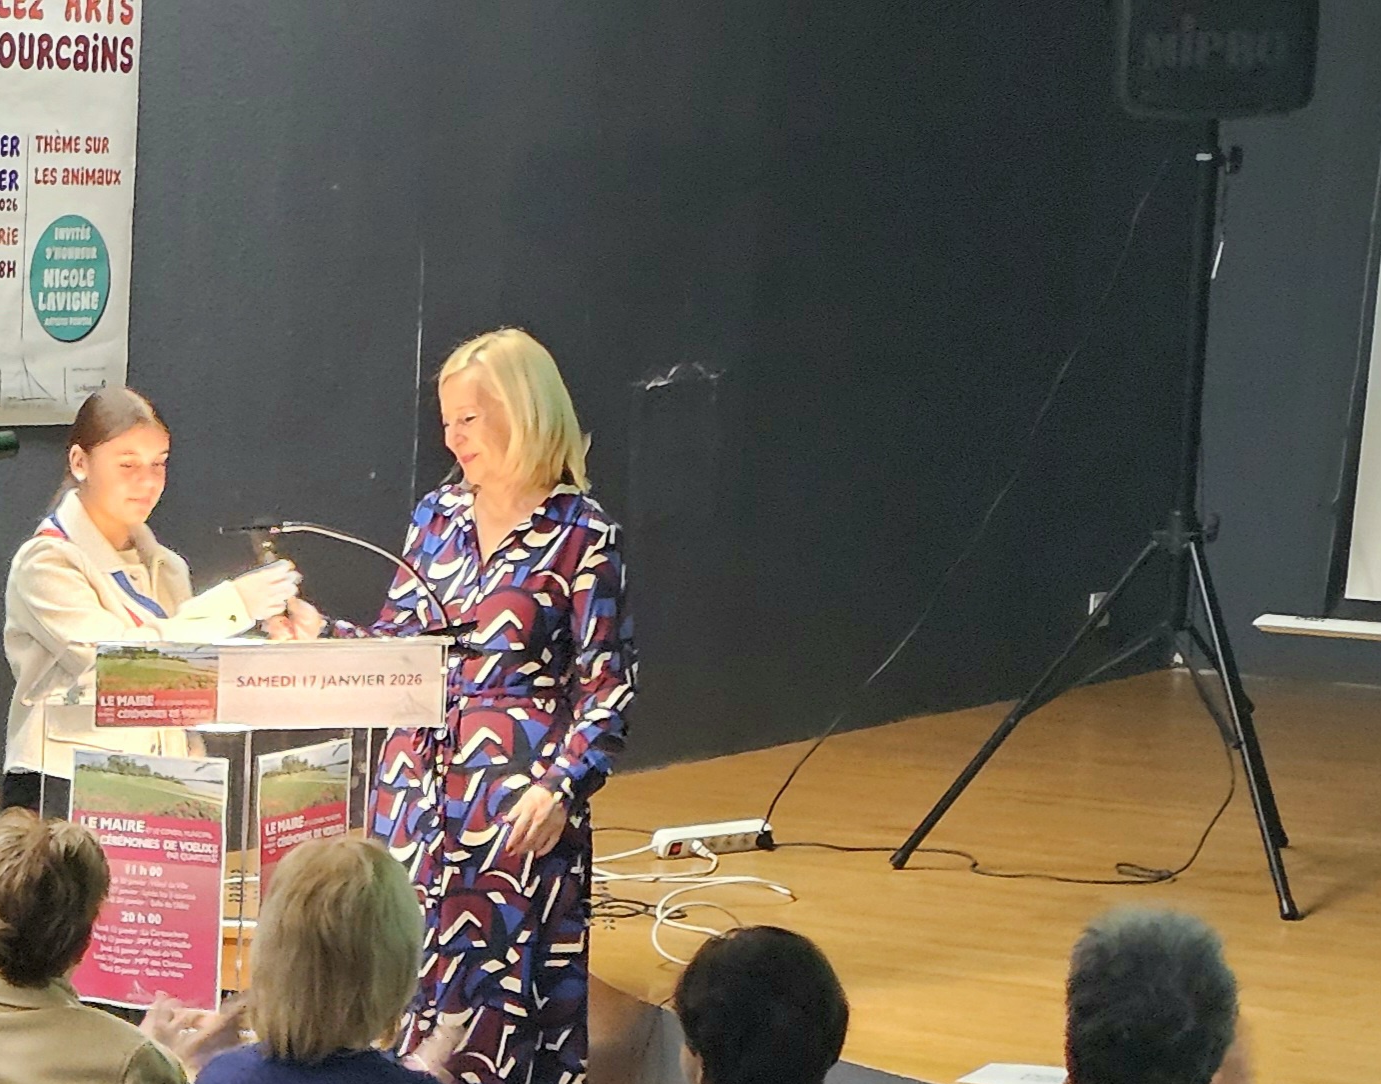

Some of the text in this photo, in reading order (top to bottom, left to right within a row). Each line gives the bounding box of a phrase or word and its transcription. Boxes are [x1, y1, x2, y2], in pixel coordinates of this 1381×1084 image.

[35, 129, 109, 154] THÈME SUR
[34, 166, 58, 186] LES
[43, 268, 96, 289] NICOLE
[38, 291, 100, 312] LAVIGNE
[236, 673, 423, 689] SAMEDI 17 JANVIER 2026
[100, 695, 115, 707] LE
[116, 695, 155, 707] MAIRE
[80, 815, 146, 833] LE MAIRE
[265, 821, 277, 837] LE
[120, 911, 136, 923] 20
